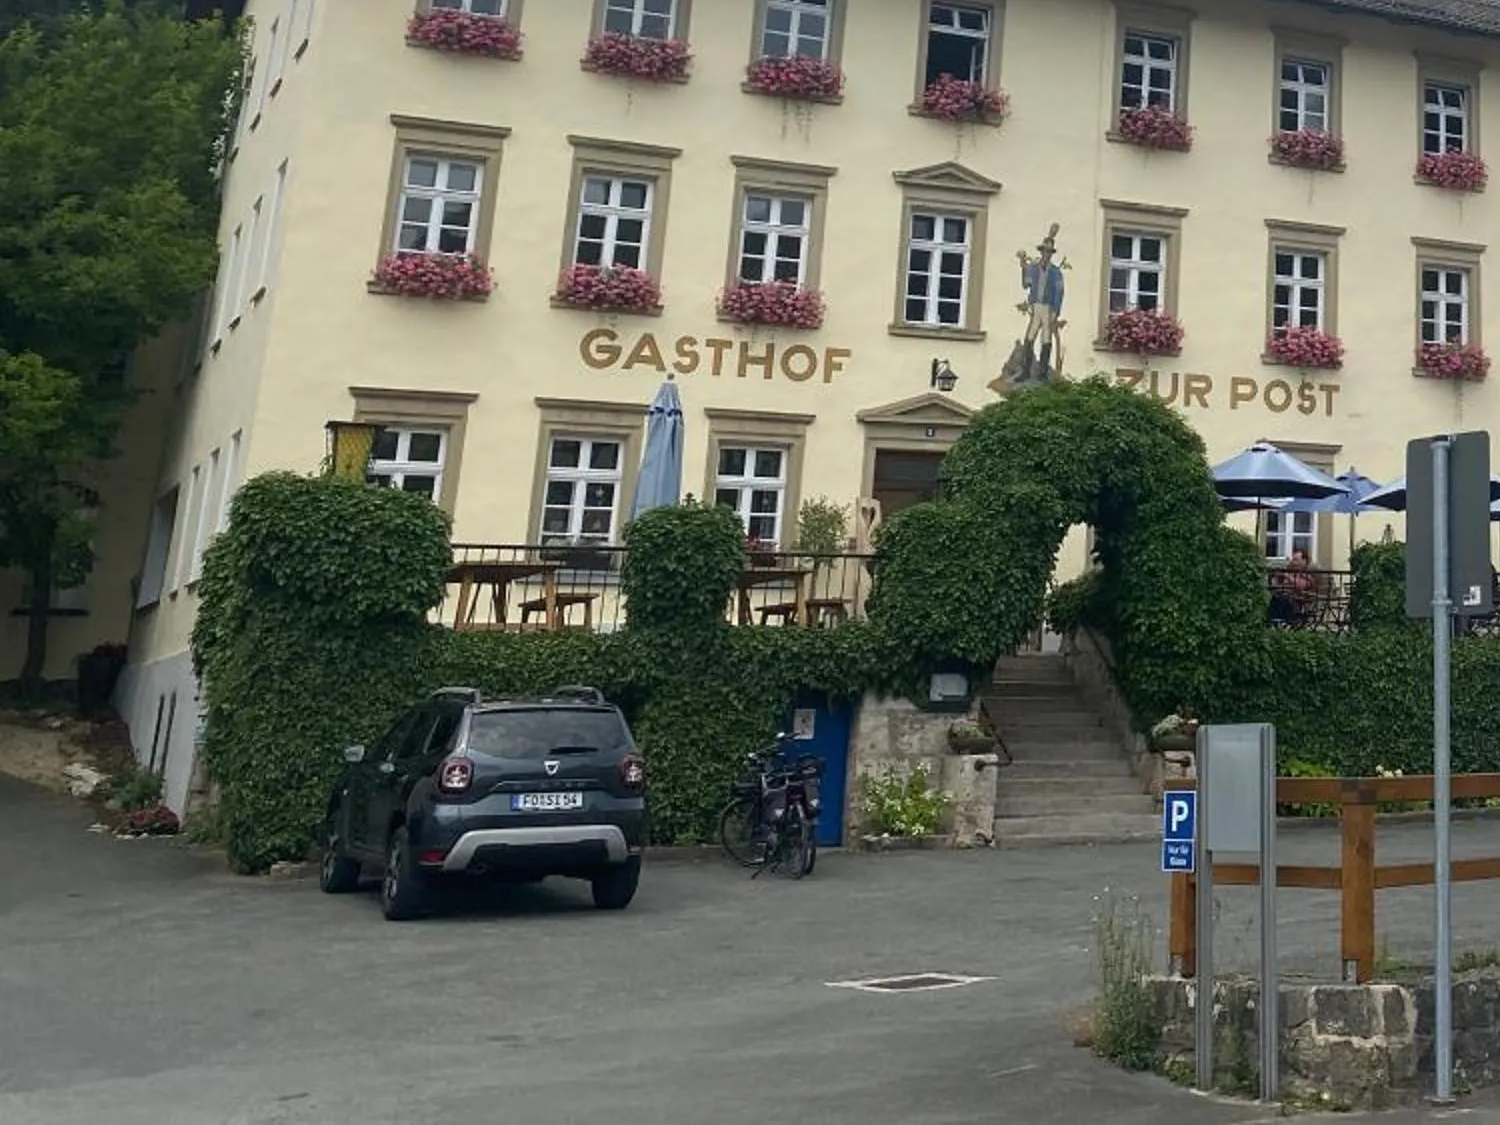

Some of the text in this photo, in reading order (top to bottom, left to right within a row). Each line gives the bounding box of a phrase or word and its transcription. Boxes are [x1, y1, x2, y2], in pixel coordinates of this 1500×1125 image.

[579, 328, 852, 384] GASTHOF
[1229, 375, 1341, 417] POST
[1171, 800, 1189, 832] P
